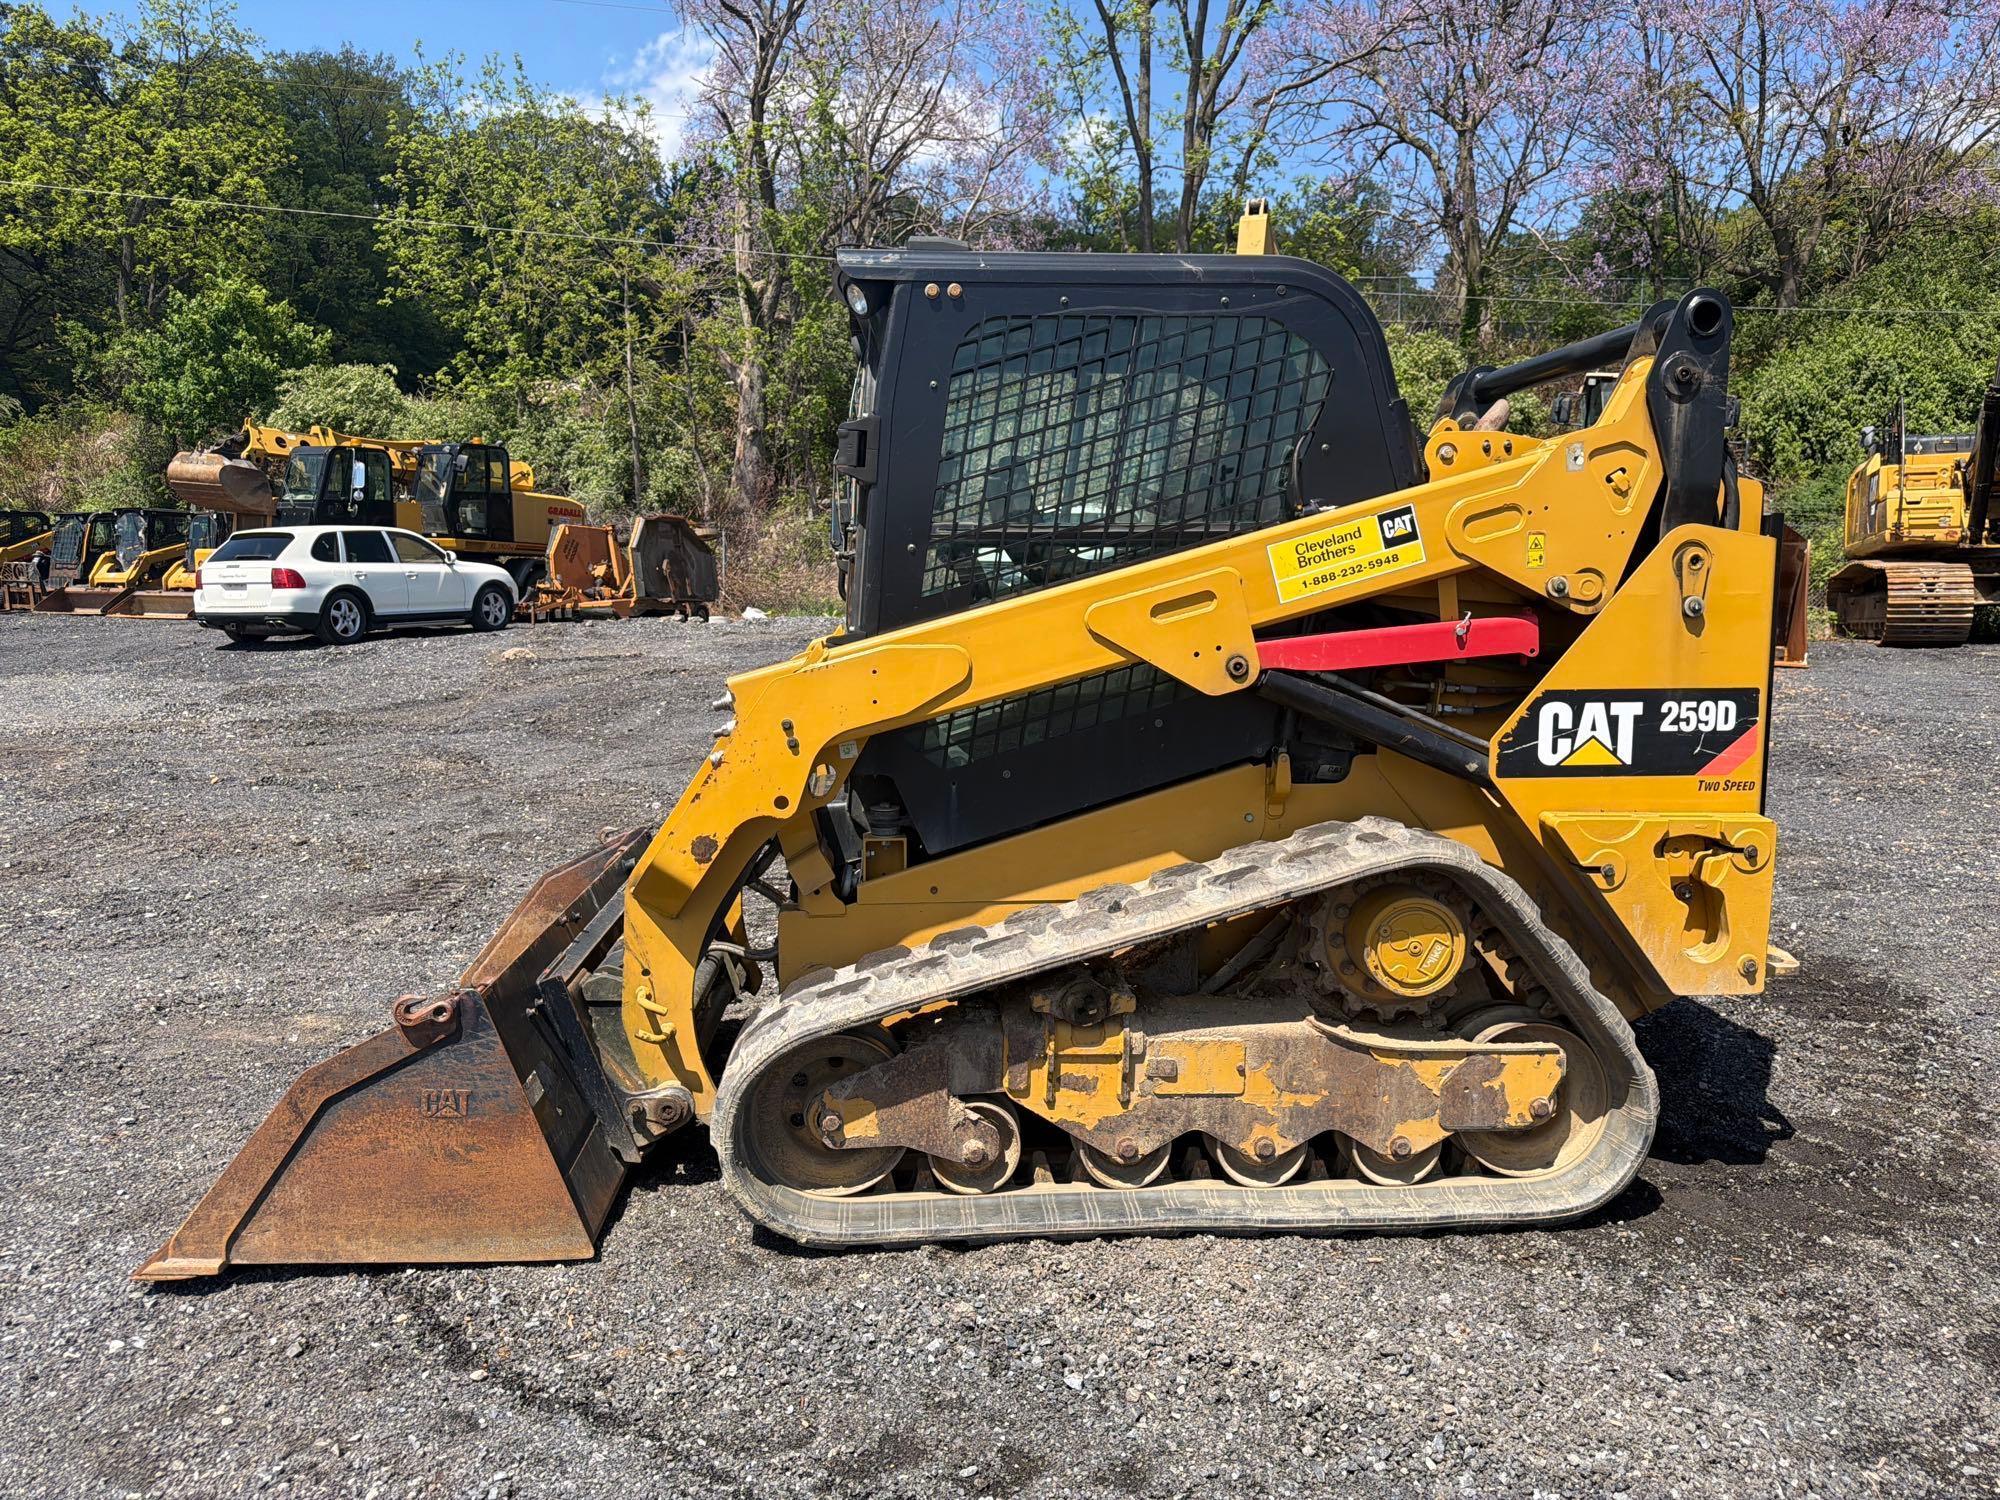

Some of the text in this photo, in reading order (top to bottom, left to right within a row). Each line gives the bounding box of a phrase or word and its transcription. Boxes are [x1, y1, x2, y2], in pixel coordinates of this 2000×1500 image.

[548, 506, 582, 517] GRADALL
[1382, 514, 1413, 539] CAT
[1295, 526, 1362, 556] Cleveland
[1297, 544, 1356, 569] Brothers
[1302, 553, 1399, 588] 1-888-232-5948
[1659, 700, 1737, 733] 259D
[1537, 701, 1644, 767] CAT
[420, 1088, 473, 1118] CAT
